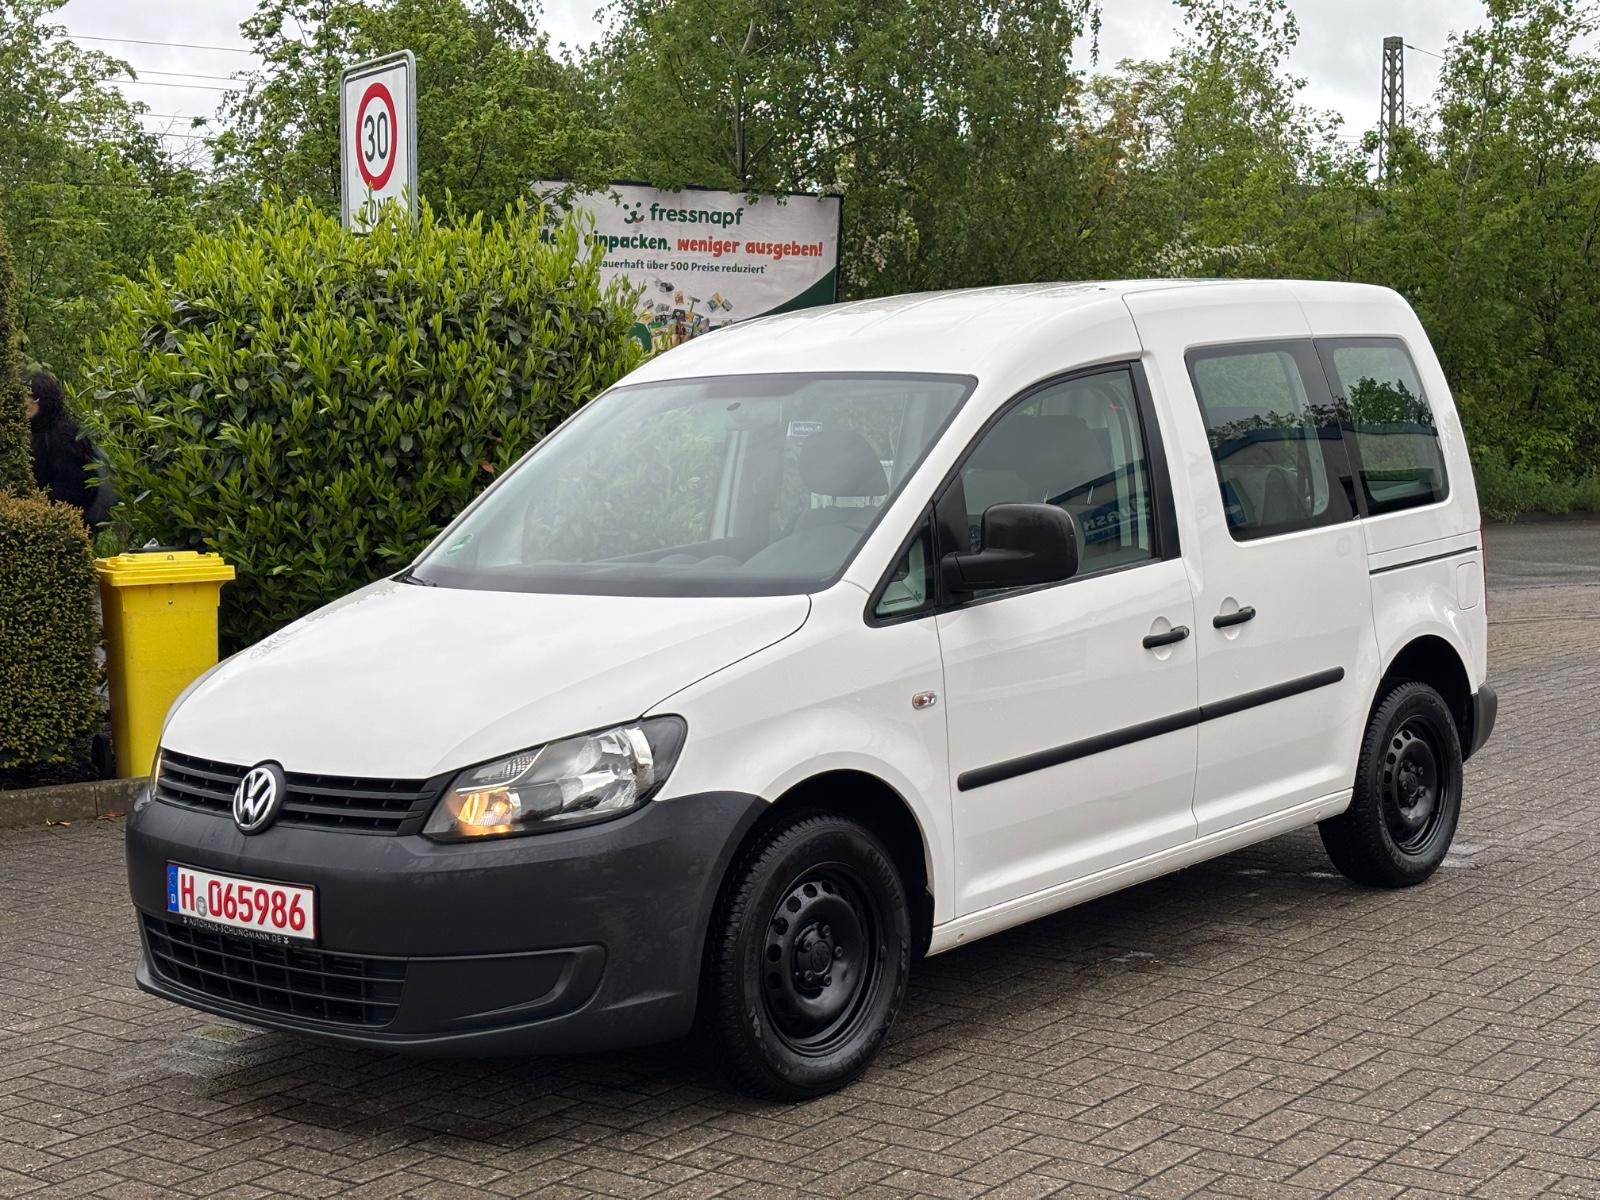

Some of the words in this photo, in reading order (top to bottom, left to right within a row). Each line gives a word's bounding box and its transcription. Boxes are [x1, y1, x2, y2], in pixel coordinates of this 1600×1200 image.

[364, 111, 388, 162] 30
[649, 203, 744, 228] fressnapf
[677, 236, 740, 257] weniger
[745, 240, 823, 260] ausgeben!
[598, 259, 644, 270] auerhaft
[646, 260, 671, 271] über
[670, 261, 689, 271] 500
[691, 262, 719, 273] Preise
[181, 873, 195, 912] H
[208, 880, 306, 931] 065986
